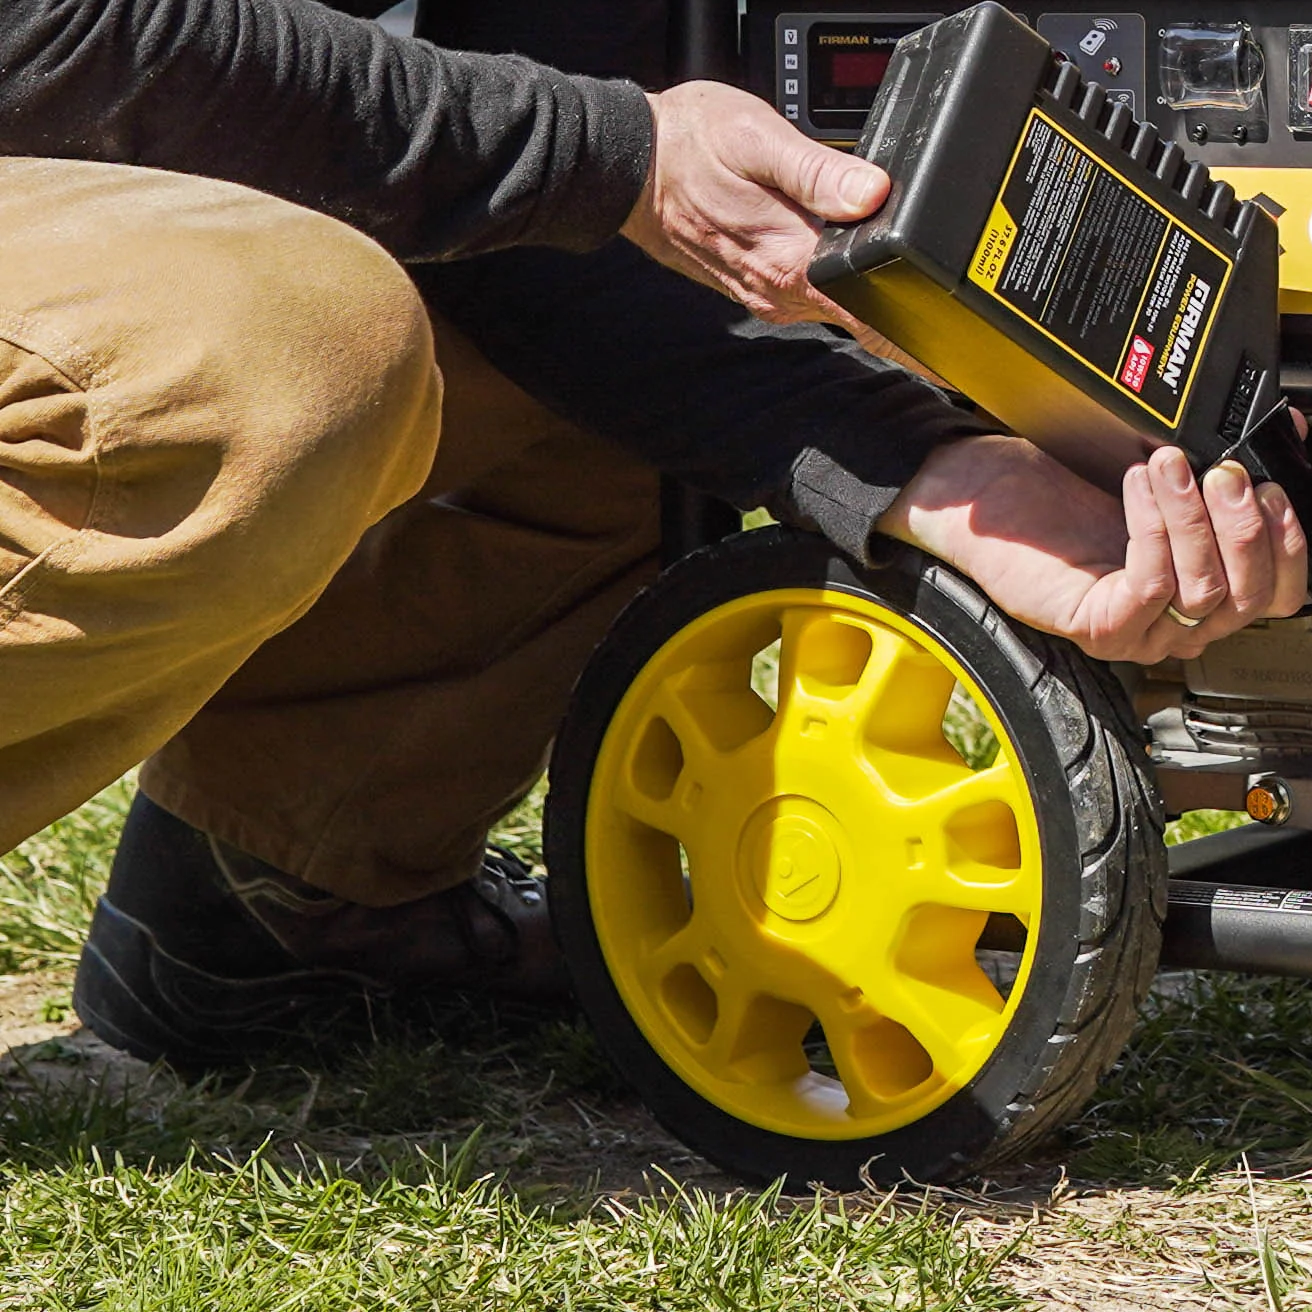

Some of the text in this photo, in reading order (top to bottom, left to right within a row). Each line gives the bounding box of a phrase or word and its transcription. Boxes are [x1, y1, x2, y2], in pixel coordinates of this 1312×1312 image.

[819, 36, 869, 44] FIRMAN
[998, 223, 1013, 248] 37.6
[1154, 271, 1197, 378] POWER EQUIPMENT
[1161, 276, 1211, 390] FIRMAN
[1130, 353, 1148, 389] 10W-30
